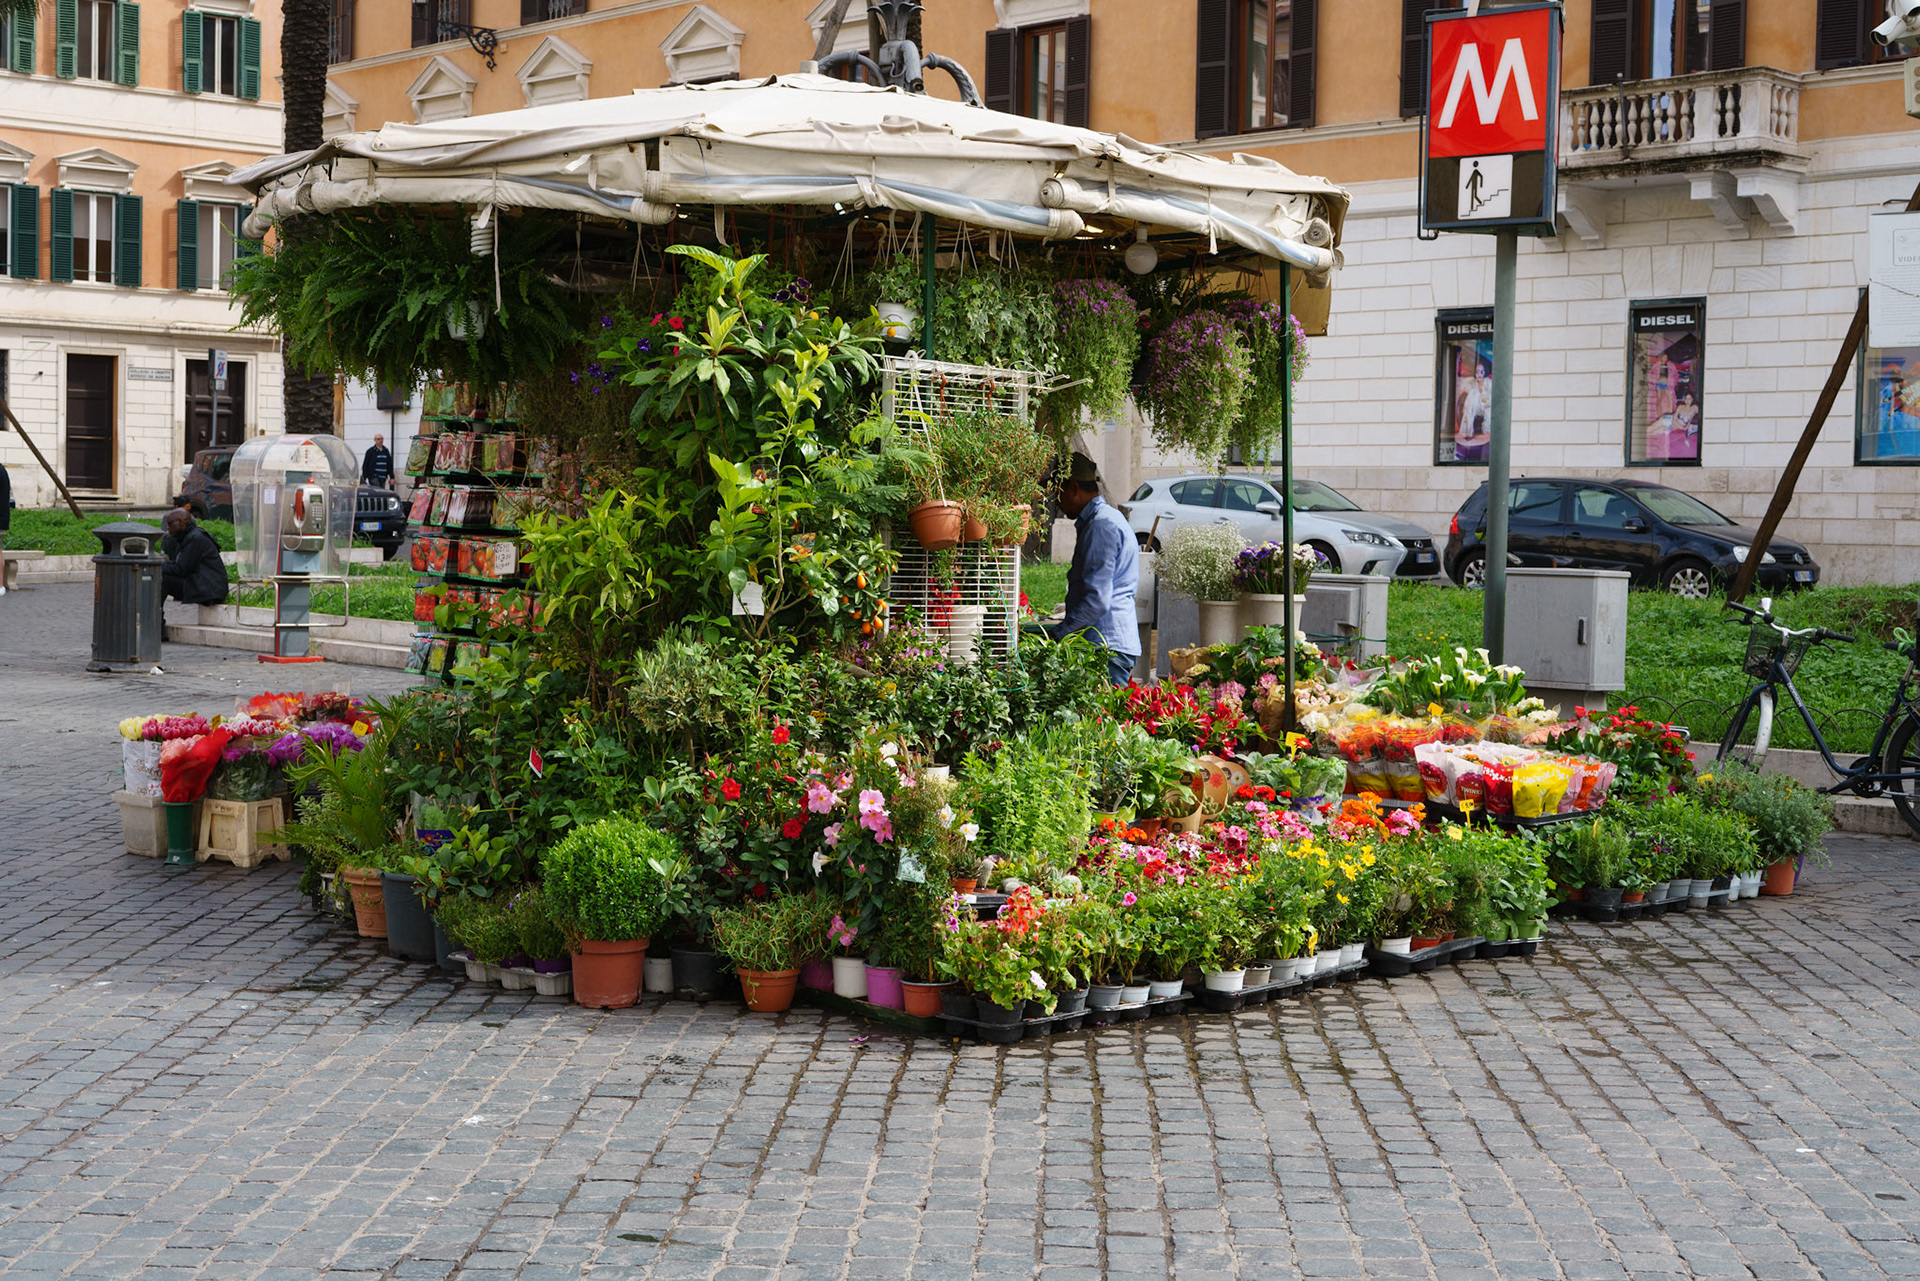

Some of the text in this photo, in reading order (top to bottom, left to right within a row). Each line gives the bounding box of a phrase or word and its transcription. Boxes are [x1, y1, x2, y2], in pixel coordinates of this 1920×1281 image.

[1437, 37, 1539, 129] M
[1640, 314, 1695, 327] DIESEL
[1447, 323, 1494, 335] DIESEL
